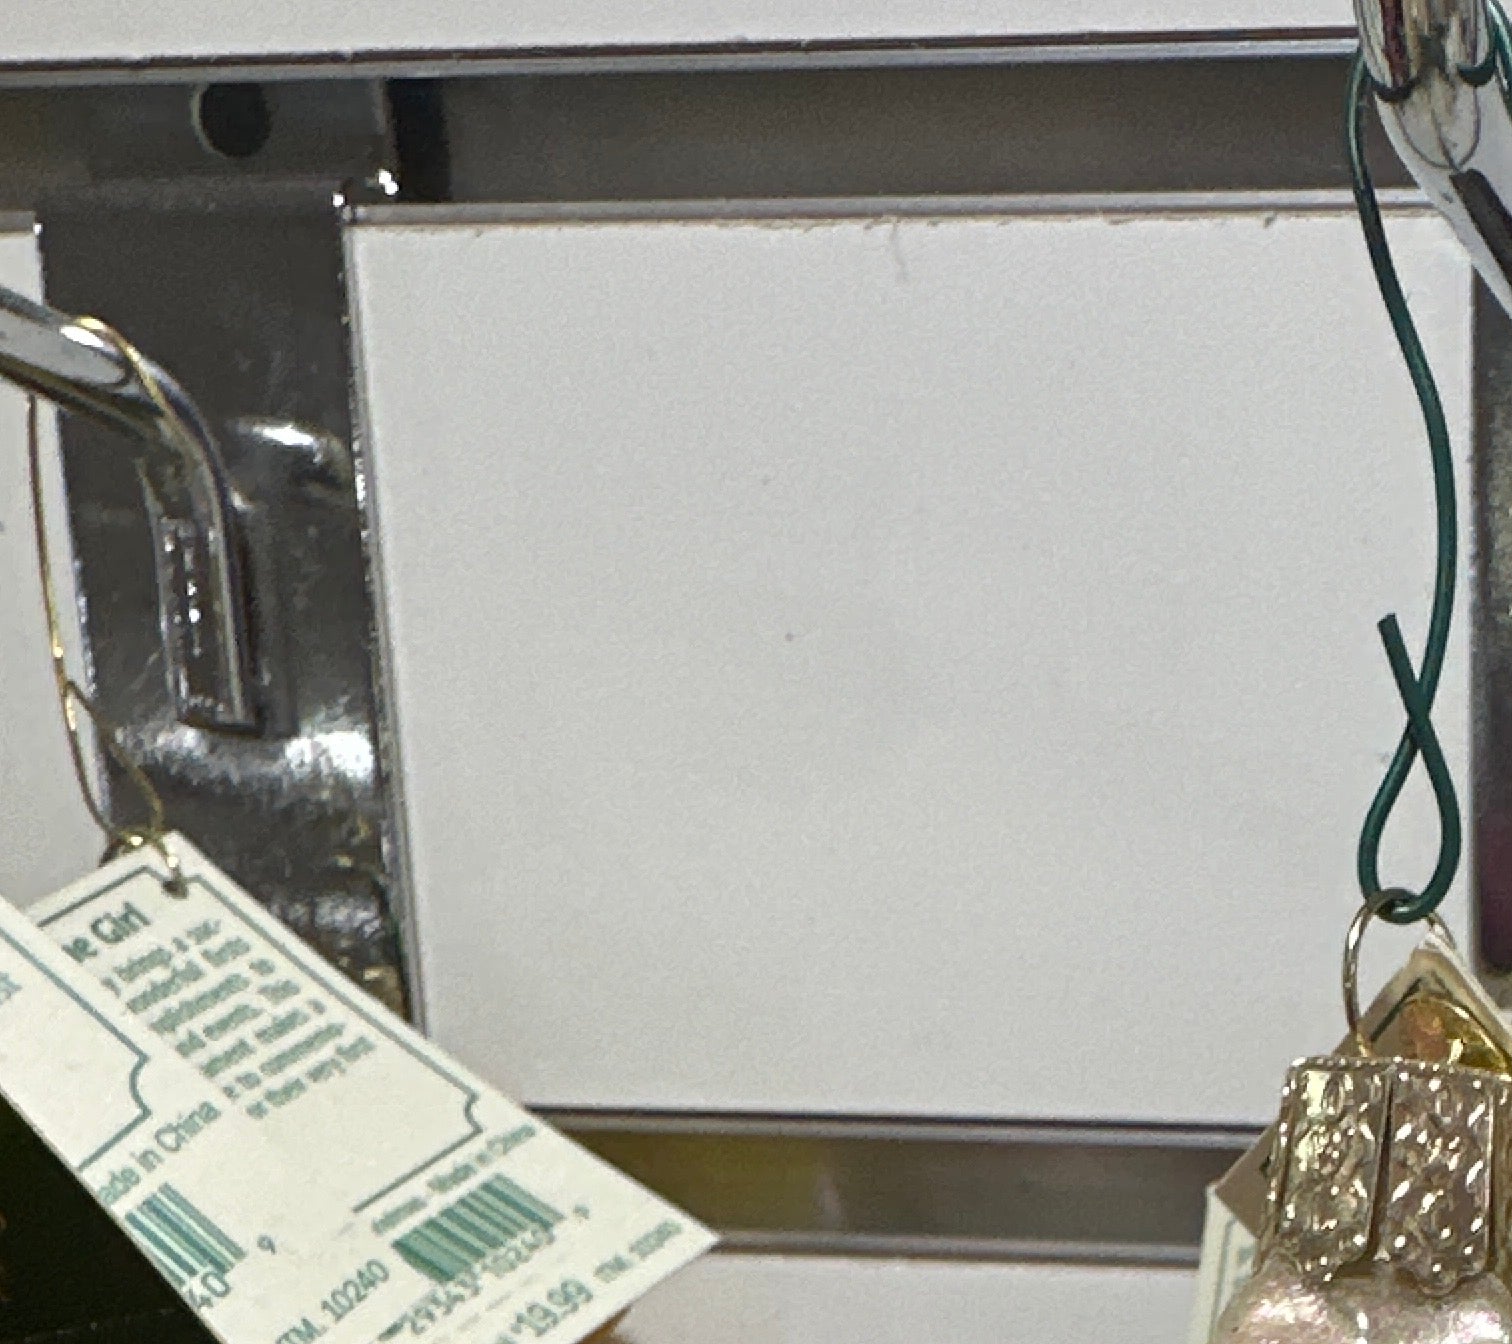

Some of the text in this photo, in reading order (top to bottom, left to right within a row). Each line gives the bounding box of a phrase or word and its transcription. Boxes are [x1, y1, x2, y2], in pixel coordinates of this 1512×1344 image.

[90, 902, 150, 944] Girl
[97, 1102, 221, 1208] ade in China
[257, 1235, 276, 1255] 9
[321, 1259, 389, 1322] 10240
